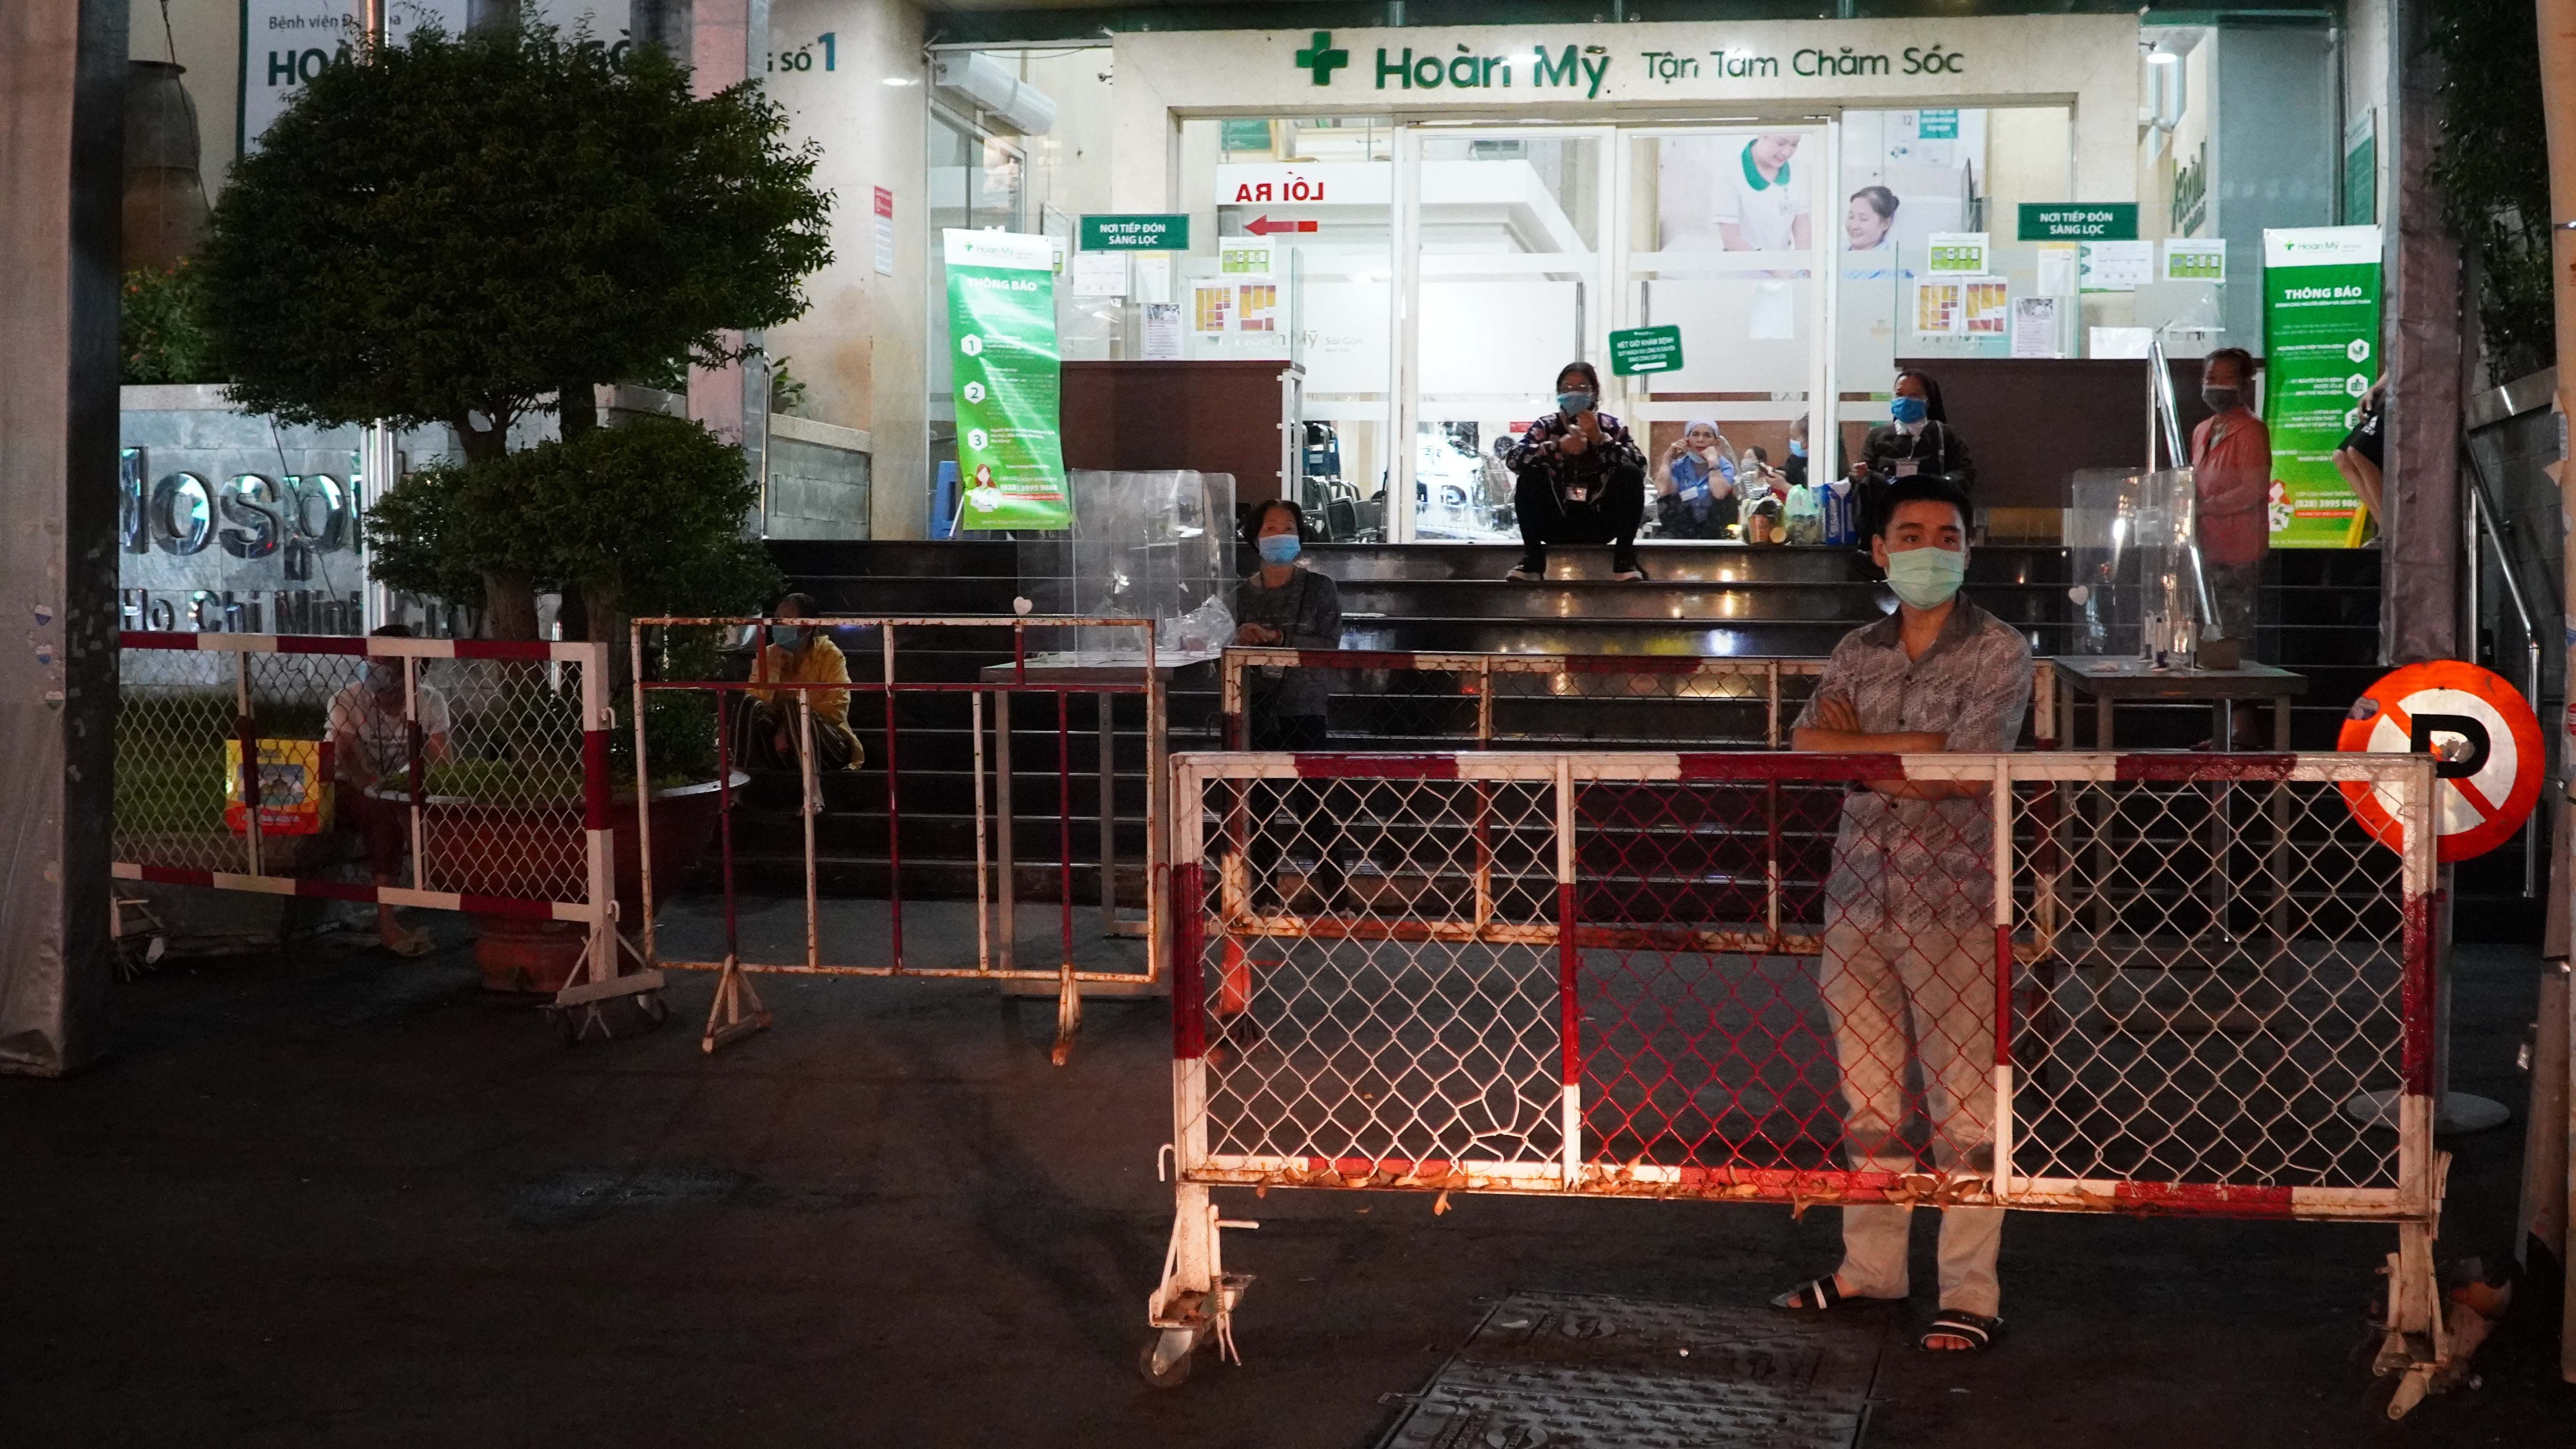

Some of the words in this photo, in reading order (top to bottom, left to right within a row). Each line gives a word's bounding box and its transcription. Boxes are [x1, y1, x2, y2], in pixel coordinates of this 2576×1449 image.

[269, 15, 304, 32] Bệnh
[309, 17, 338, 30] viện
[817, 32, 835, 72] 1
[1641, 51, 1699, 84] Tận
[1792, 46, 1889, 76] Chăm
[1902, 44, 1964, 75] Sóc
[1375, 43, 1512, 89] Hoàn
[1534, 44, 1611, 99] Mỹ
[2063, 210, 2086, 222] TIẾP
[2087, 210, 2113, 222] ĐÓN
[1119, 221, 1141, 233] TIẾP
[1142, 222, 1166, 233] ĐÓN
[2082, 224, 2105, 236] LỌC
[1138, 235, 1158, 246] LỌC
[966, 276, 1009, 290] THÔNG
[1011, 279, 1038, 292] BÁO
[2284, 286, 2331, 300] THÔNG
[2333, 285, 2362, 298] BÁO
[968, 340, 974, 351] 1
[970, 387, 979, 399] 2
[974, 434, 981, 446] 3
[2411, 713, 2491, 778] P
